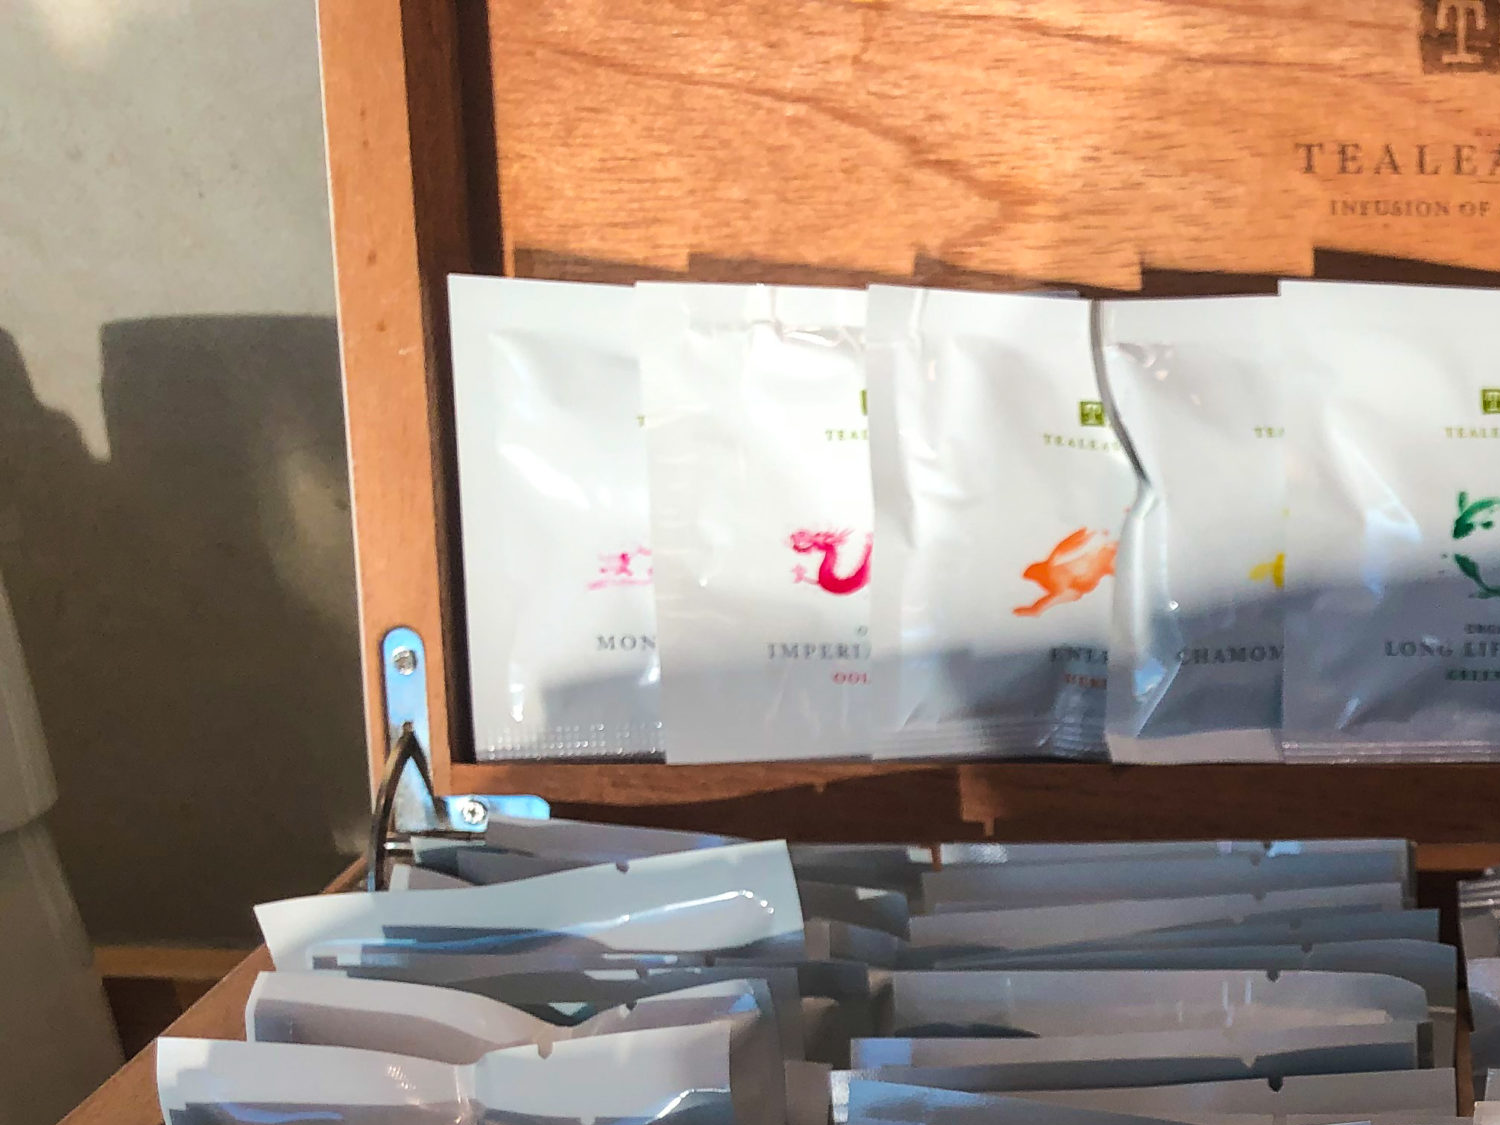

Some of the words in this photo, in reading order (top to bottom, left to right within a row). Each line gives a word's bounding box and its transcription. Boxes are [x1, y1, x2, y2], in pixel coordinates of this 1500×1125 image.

[1330, 200, 1450, 217] INFUSION
[1460, 200, 1491, 216] OF
[1384, 640, 1453, 658] LONG
